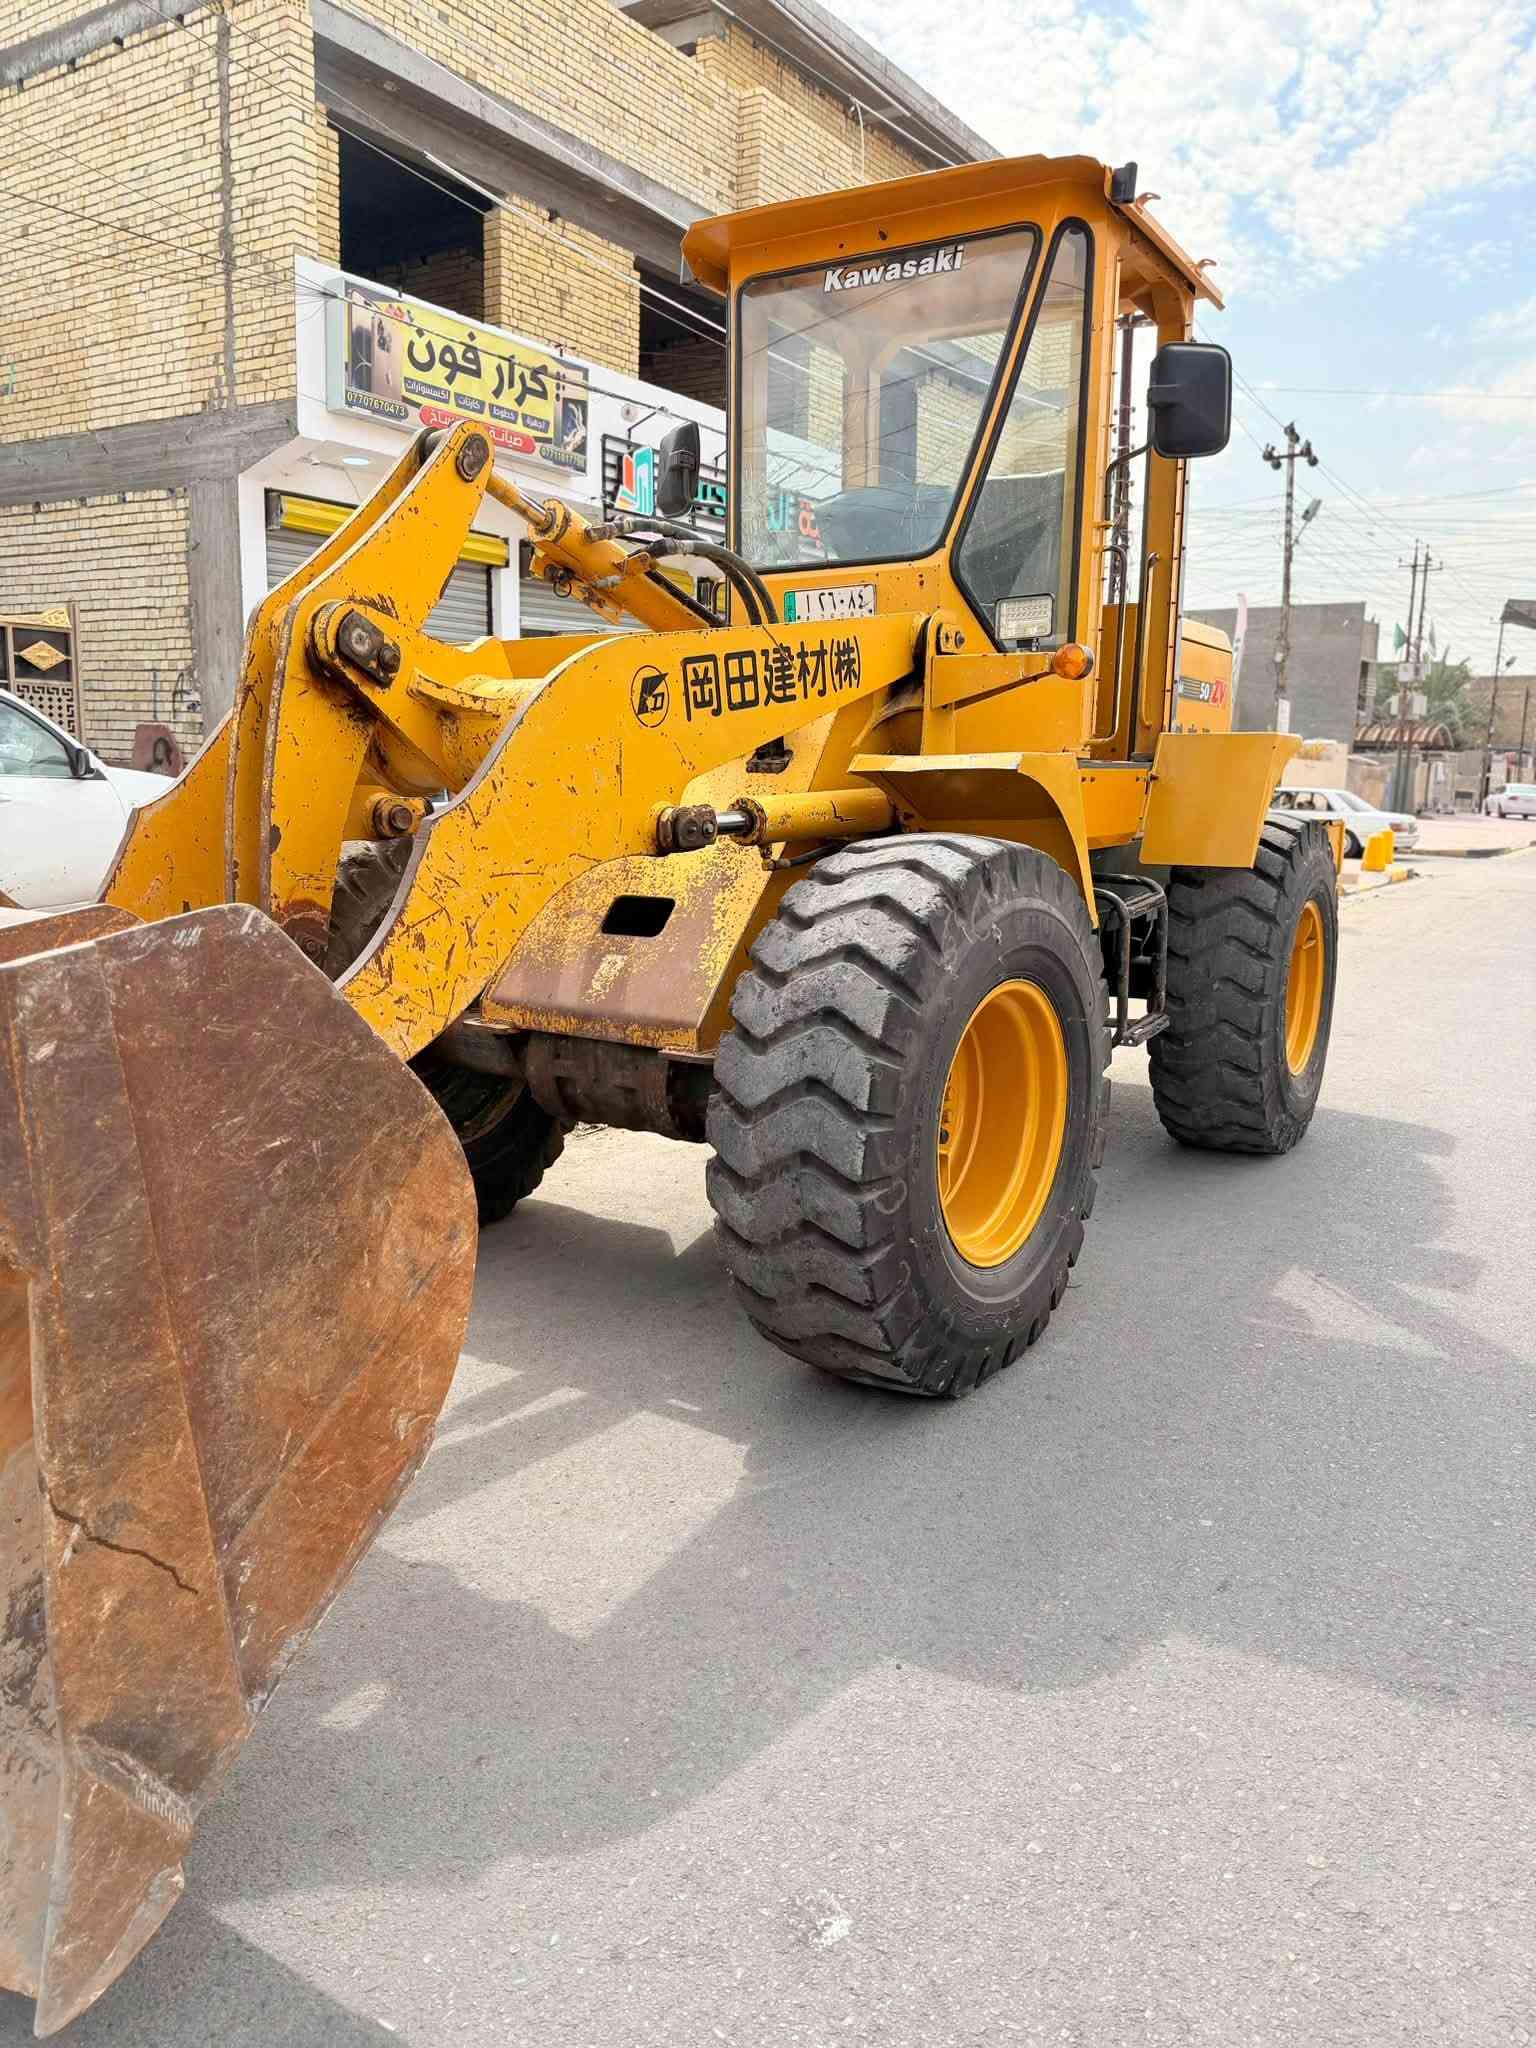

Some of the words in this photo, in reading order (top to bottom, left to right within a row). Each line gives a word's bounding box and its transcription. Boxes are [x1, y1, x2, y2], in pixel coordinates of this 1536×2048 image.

[823, 245, 965, 293] Kawasaki
[408, 328, 482, 386] فون
[491, 355, 548, 406] كرار
[346, 391, 405, 417] 07707670473
